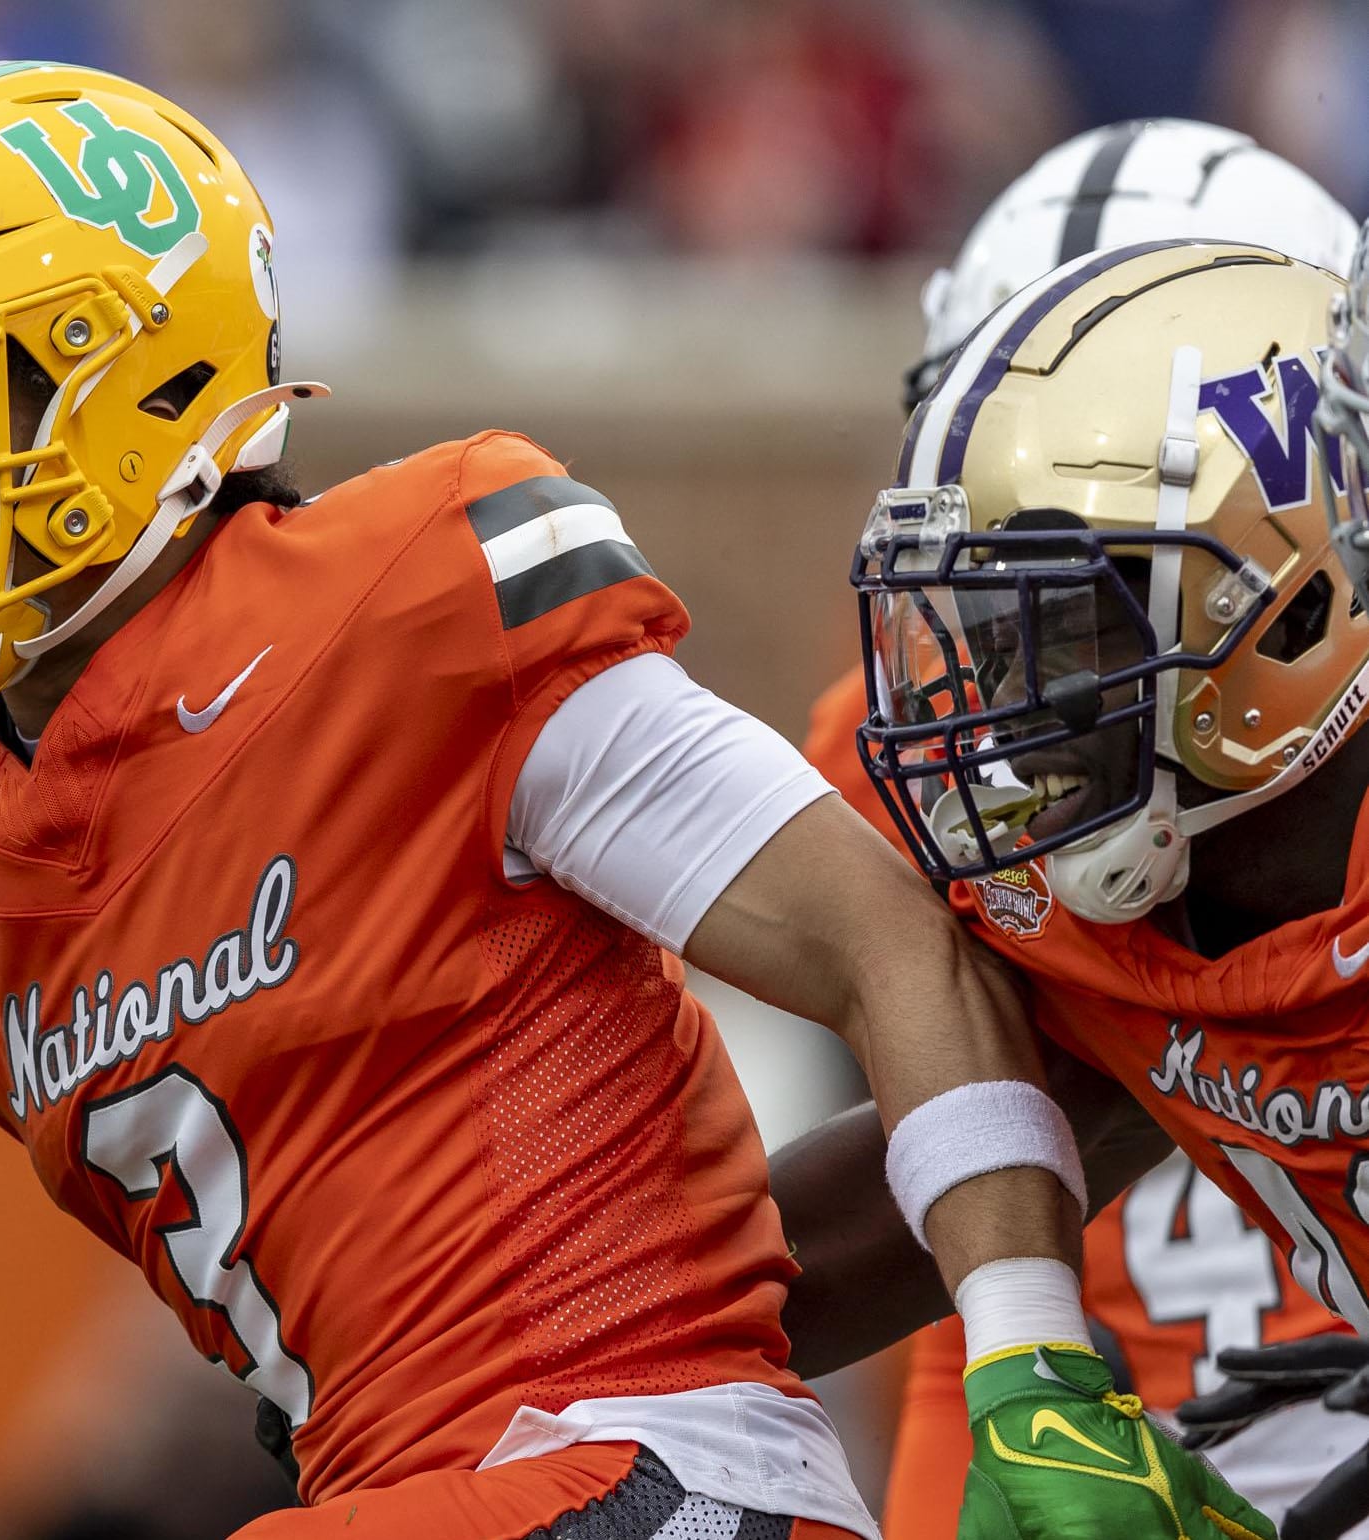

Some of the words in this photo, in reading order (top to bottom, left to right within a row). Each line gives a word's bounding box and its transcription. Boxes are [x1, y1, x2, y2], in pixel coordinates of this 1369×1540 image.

[1197, 346, 1369, 514] W
[995, 868, 1031, 886] eese's
[3, 853, 299, 1123] National
[1147, 1018, 1369, 1147] Nation
[82, 1061, 314, 1432] 3
